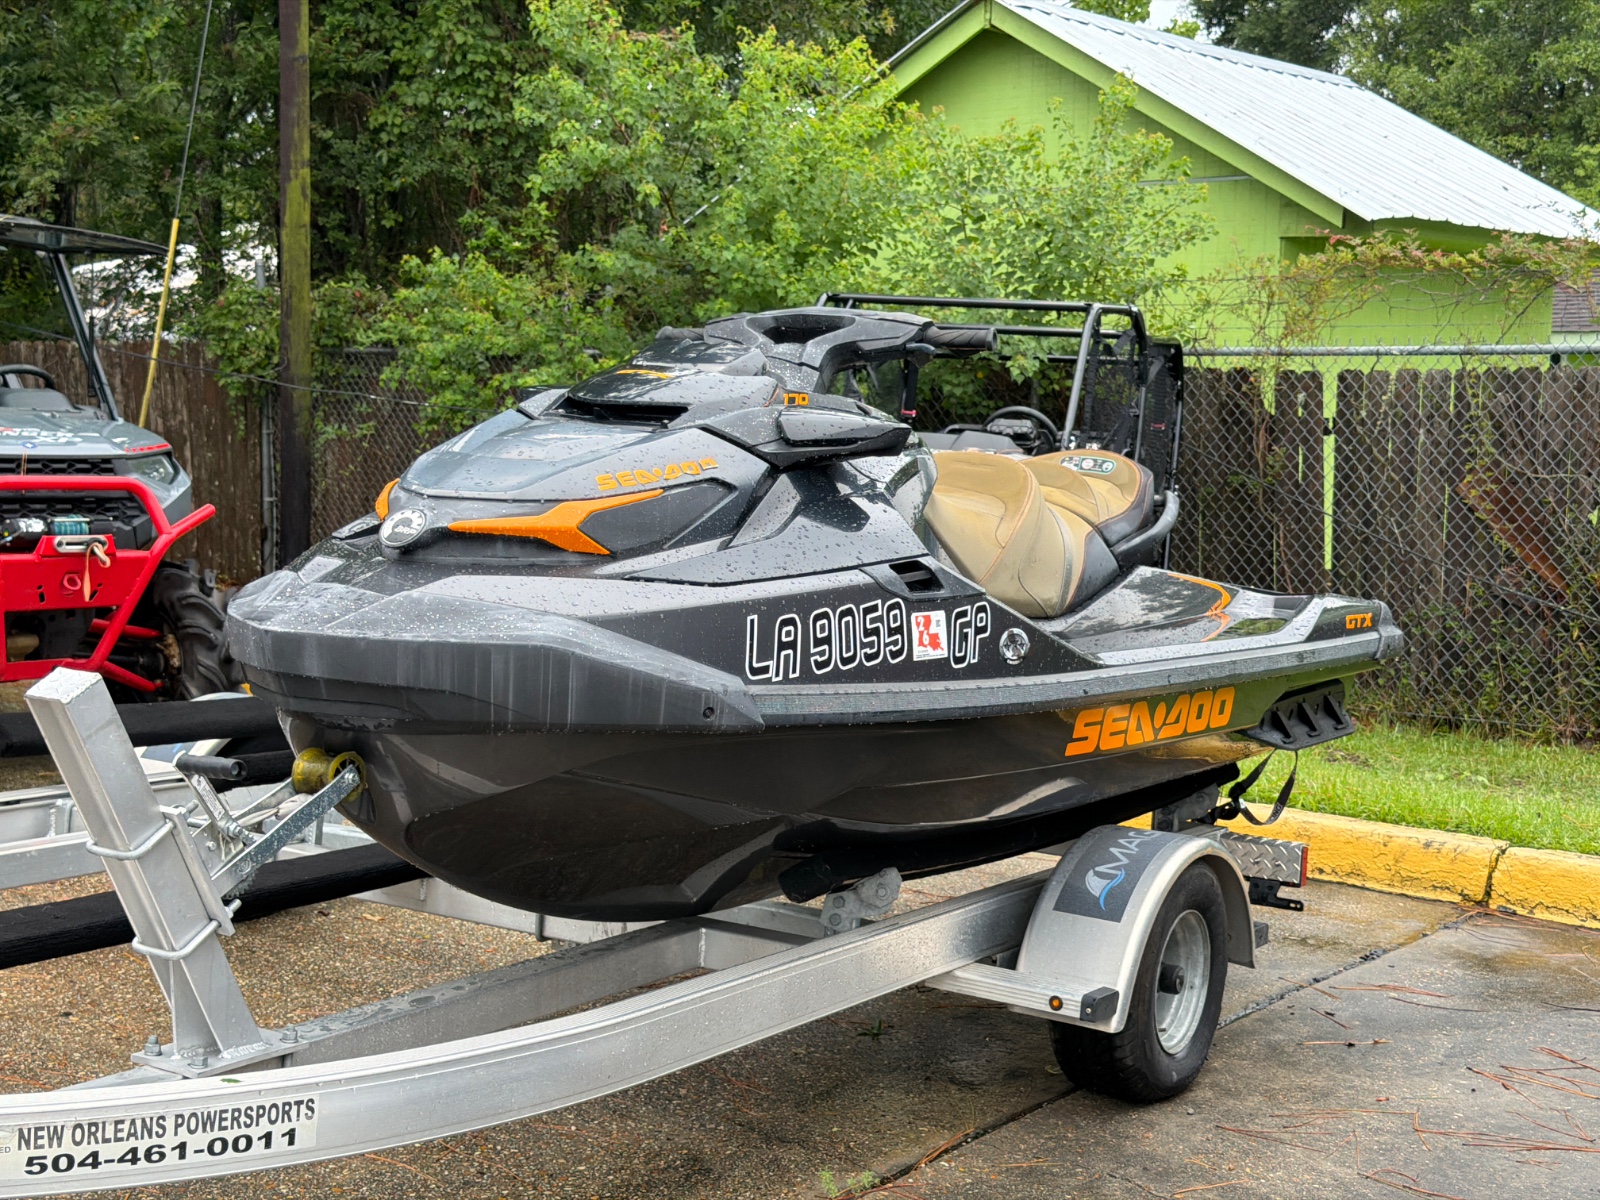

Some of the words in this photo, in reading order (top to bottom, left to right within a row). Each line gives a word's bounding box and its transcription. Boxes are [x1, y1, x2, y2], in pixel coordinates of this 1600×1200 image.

[783, 393, 809, 406] 170
[745, 612, 802, 682] LA
[809, 597, 907, 675] 9059
[950, 601, 991, 669] GP
[1345, 612, 1373, 630] GTX
[17, 1124, 66, 1151] NEW
[71, 1115, 167, 1147] ORLEANS
[173, 1098, 316, 1137] POWERSPORTS
[24, 1127, 297, 1176] 504-461-0011
